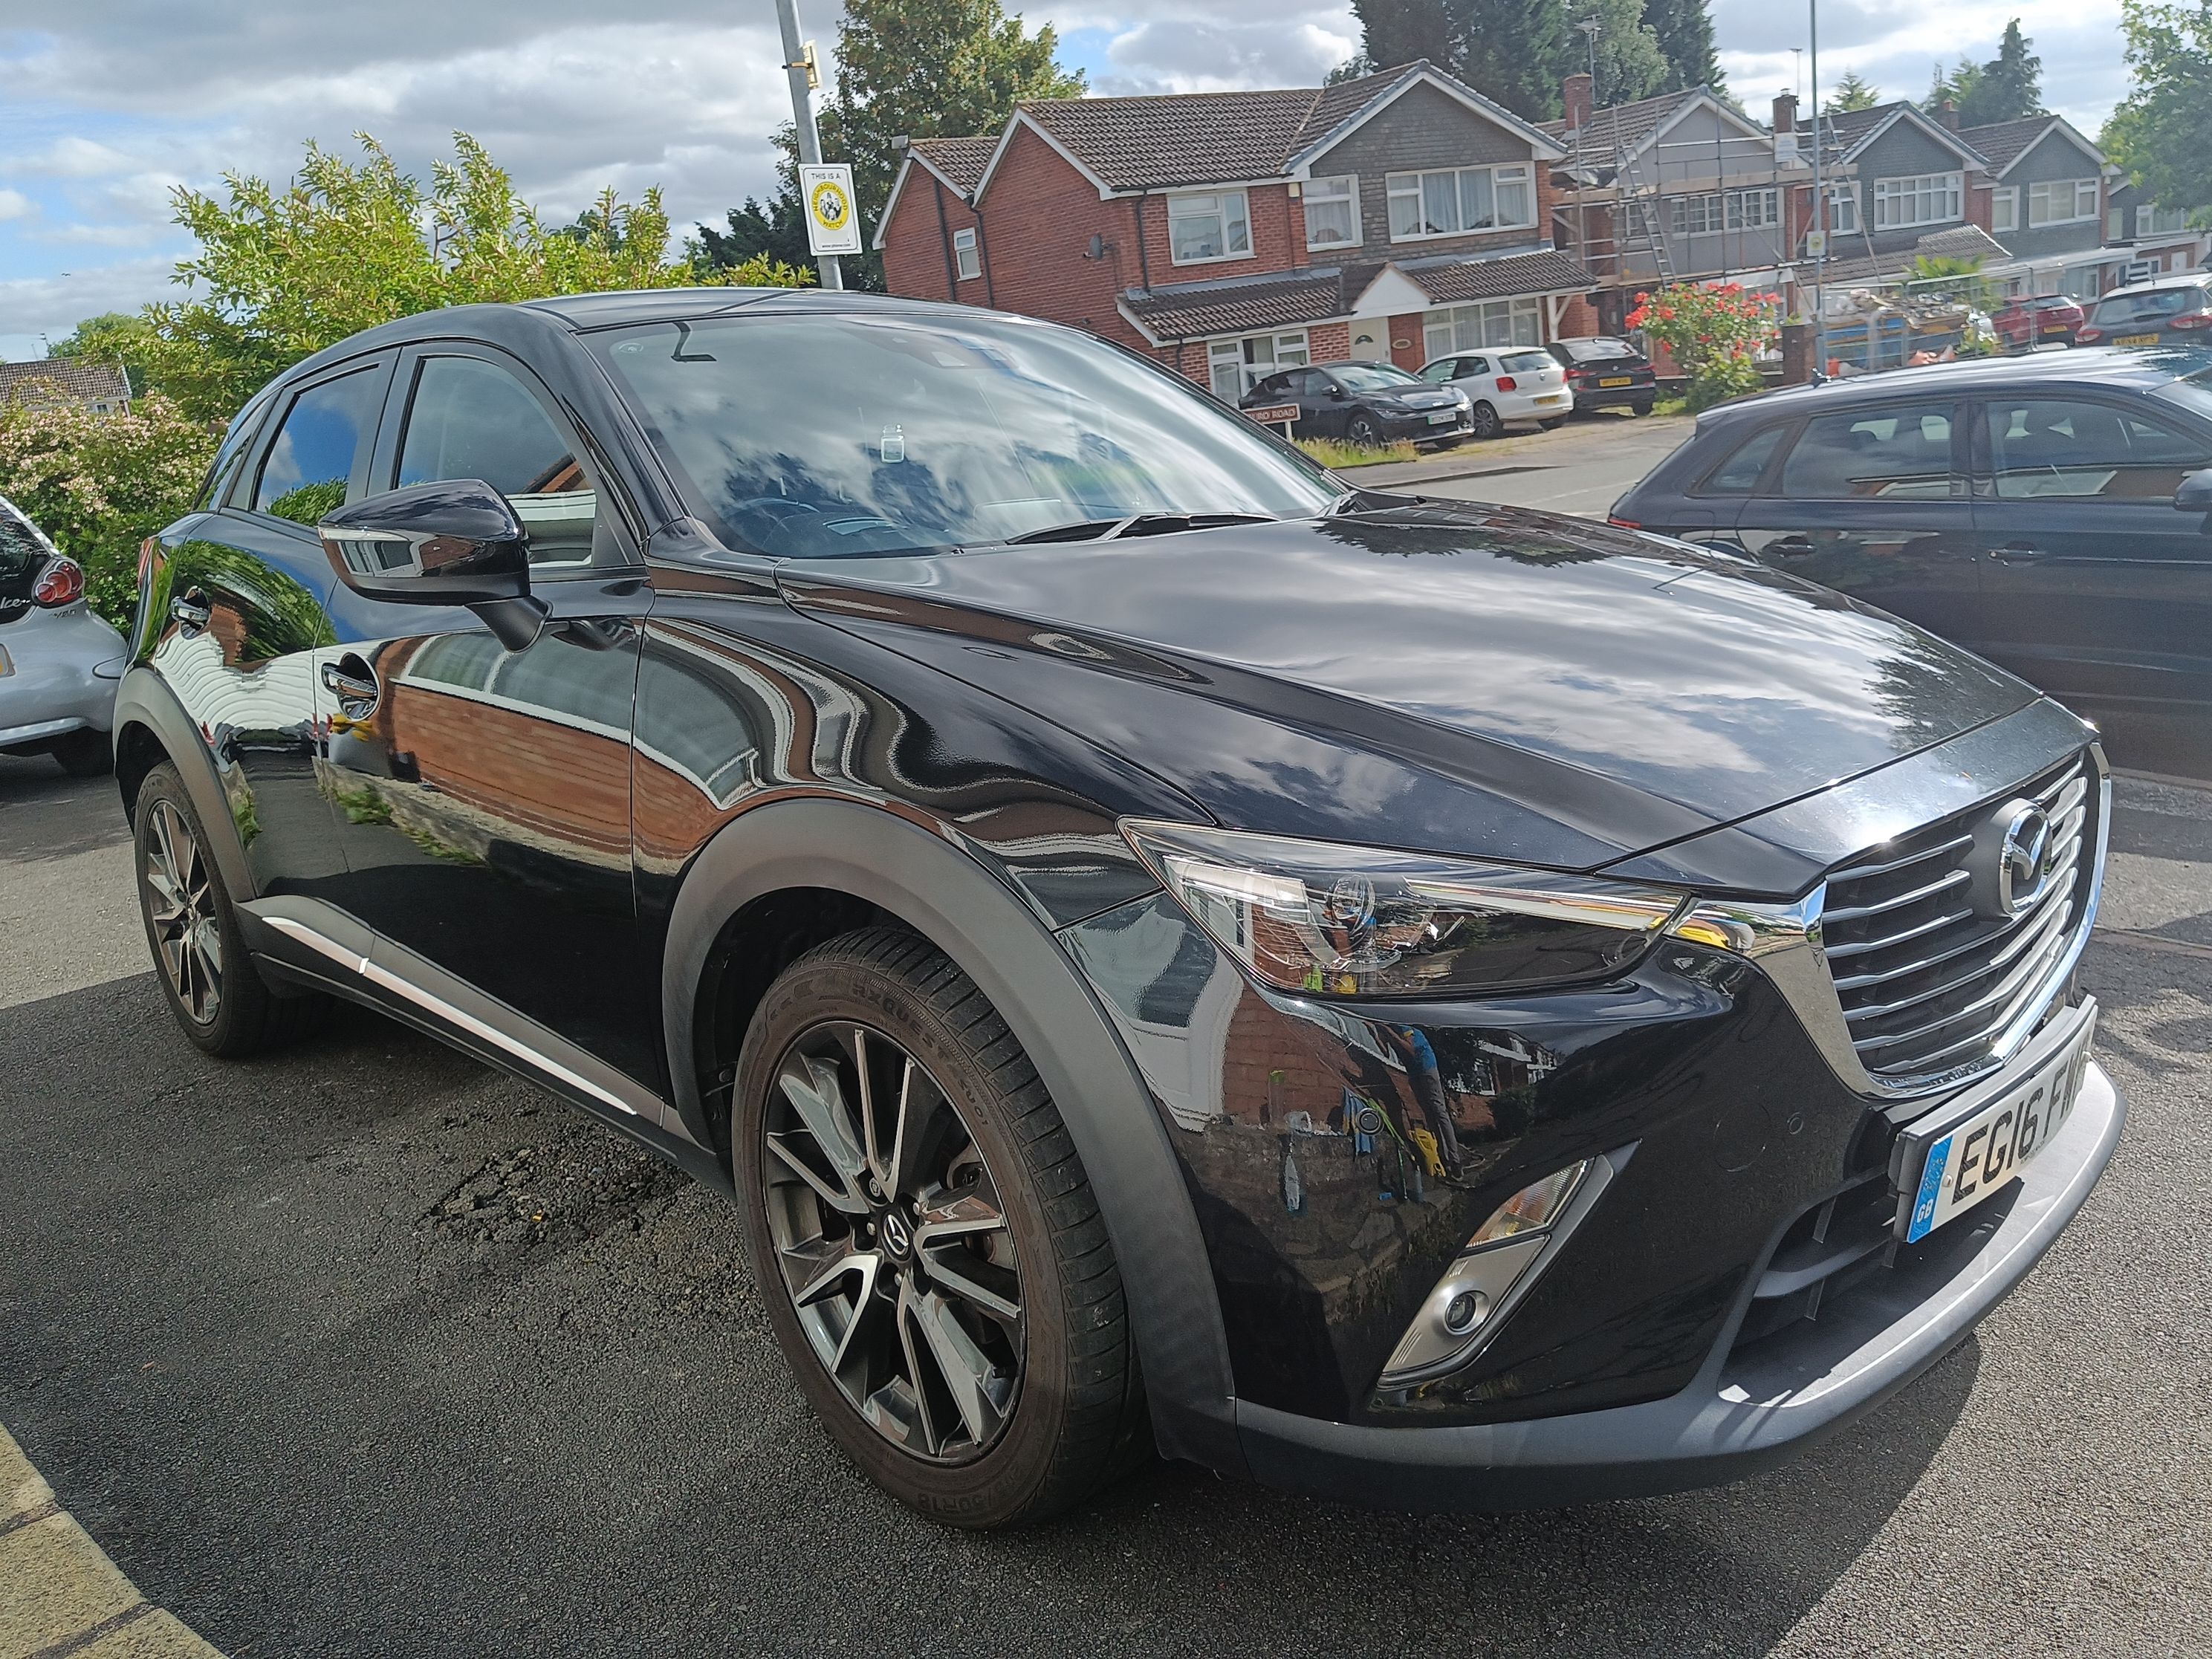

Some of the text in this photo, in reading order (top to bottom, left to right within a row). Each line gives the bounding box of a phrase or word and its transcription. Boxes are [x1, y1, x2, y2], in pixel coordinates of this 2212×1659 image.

[823, 220, 843, 229] WATCH
[1271, 407, 1296, 418] ROAD
[1951, 1087, 2043, 1207] EG16
[1917, 1198, 1934, 1224] GB
